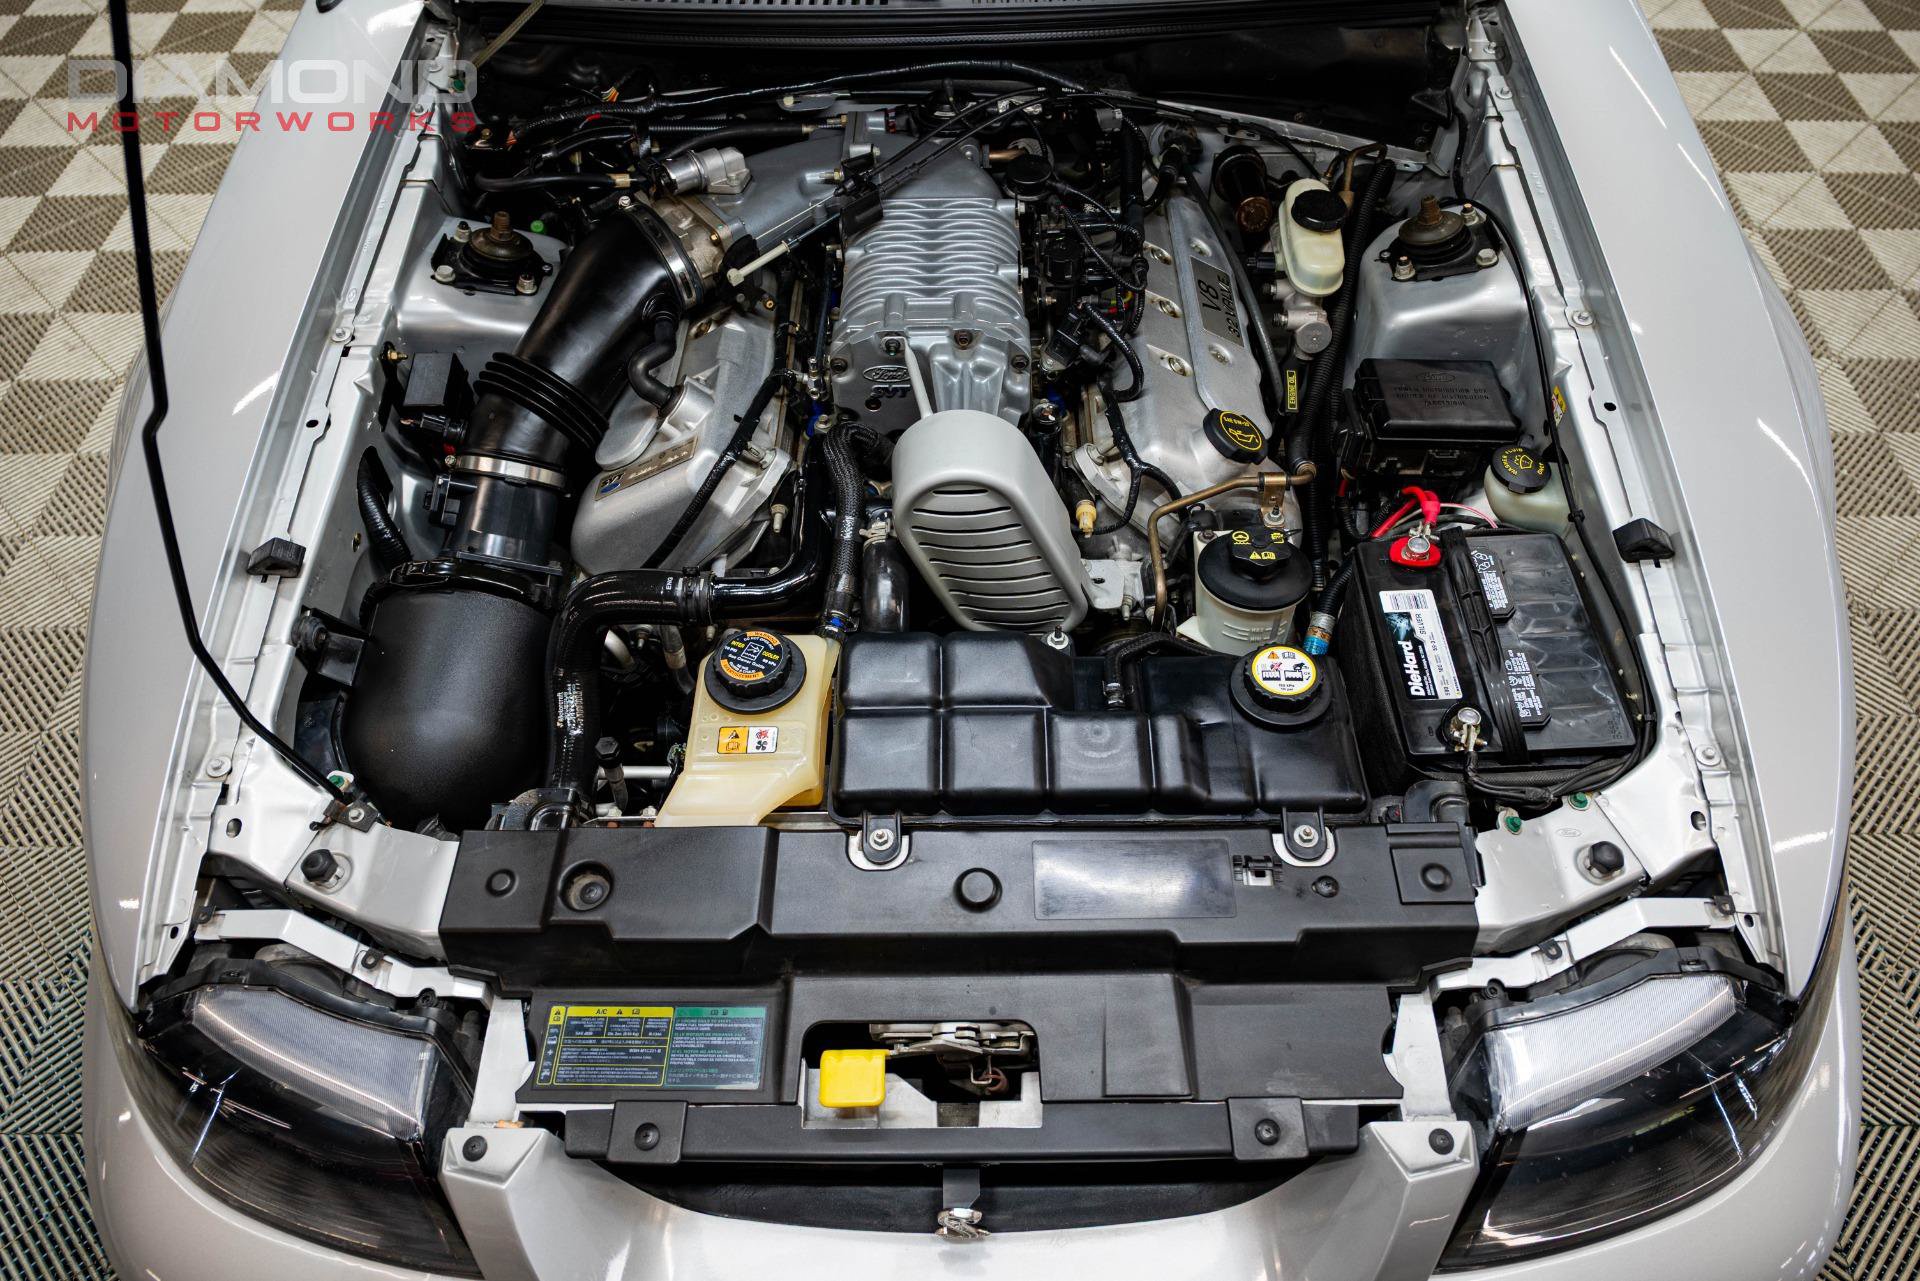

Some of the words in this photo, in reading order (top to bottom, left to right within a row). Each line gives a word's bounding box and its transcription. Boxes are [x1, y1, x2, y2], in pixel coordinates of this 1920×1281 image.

[1197, 279, 1222, 312] V8
[1215, 273, 1237, 319] VALVE
[1288, 375, 1296, 384] OIL
[870, 384, 911, 399] SVT
[1288, 384, 1297, 405] ENGINE
[1504, 447, 1523, 455] FLUID
[1501, 455, 1518, 476] WASHER
[665, 576, 673, 590] ENG
[1415, 613, 1427, 635] SILVER
[730, 640, 746, 648] INTER
[761, 650, 780, 660] COOLER
[1397, 640, 1427, 697] DieHard
